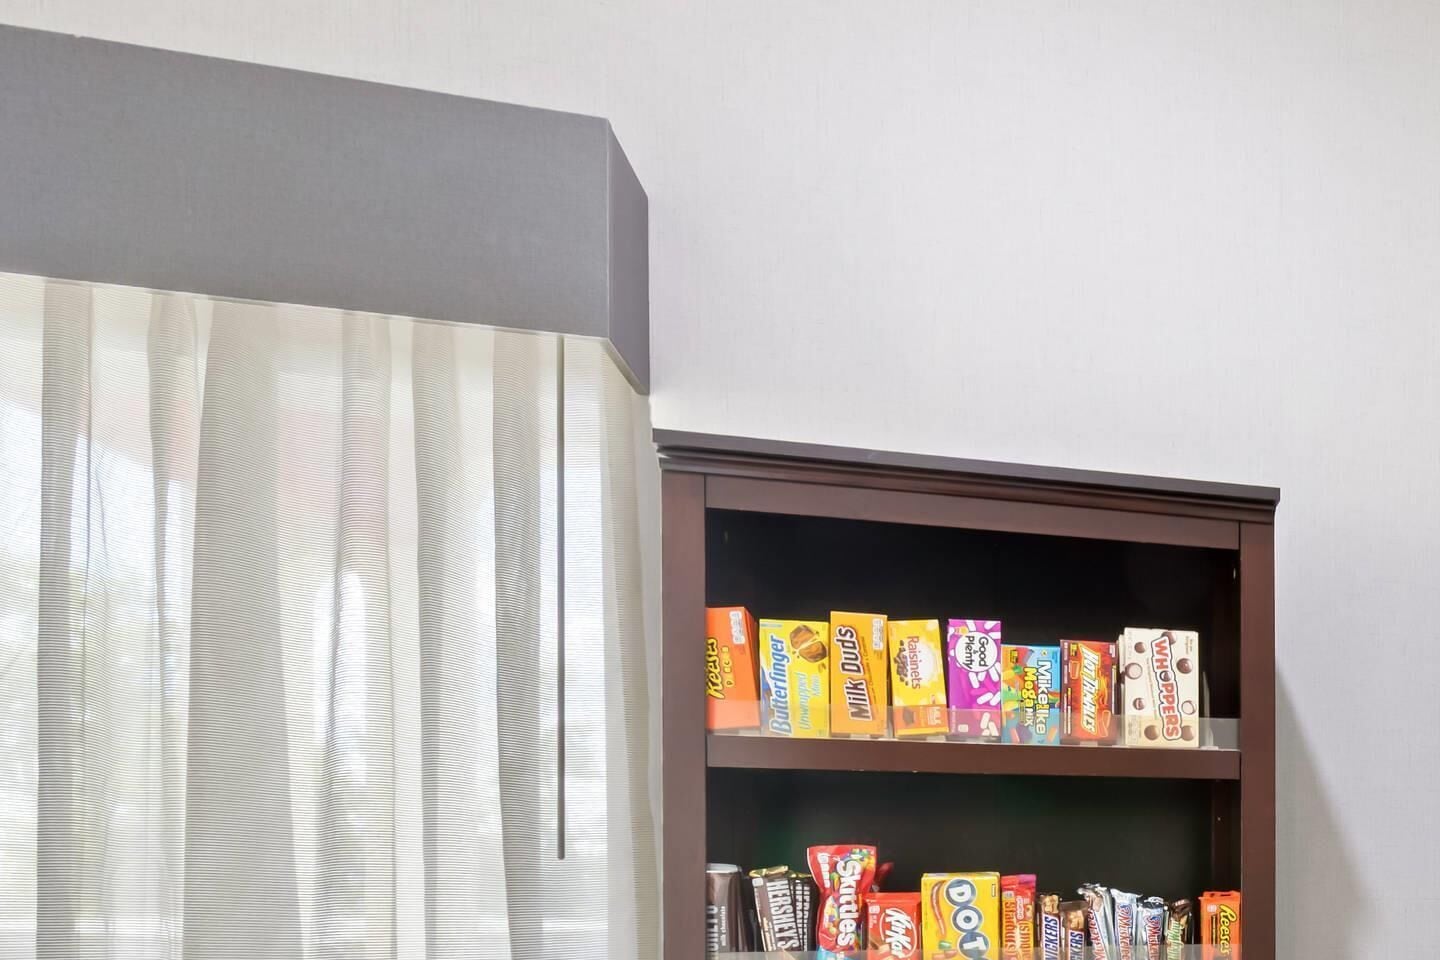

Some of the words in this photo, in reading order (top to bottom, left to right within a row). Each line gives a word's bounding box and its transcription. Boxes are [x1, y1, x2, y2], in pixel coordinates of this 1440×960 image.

[834, 624, 864, 676] Duds
[907, 635, 921, 689] Raisinets
[978, 636, 988, 667] Good
[769, 634, 793, 735] Butterfinger
[845, 677, 873, 720] Milk
[1036, 660, 1052, 705] Mike
[1153, 639, 1181, 738] WHOPPERS
[1035, 709, 1049, 735] Ike
[766, 879, 801, 950] HERSHEY'S
[836, 859, 862, 947] Skittles
